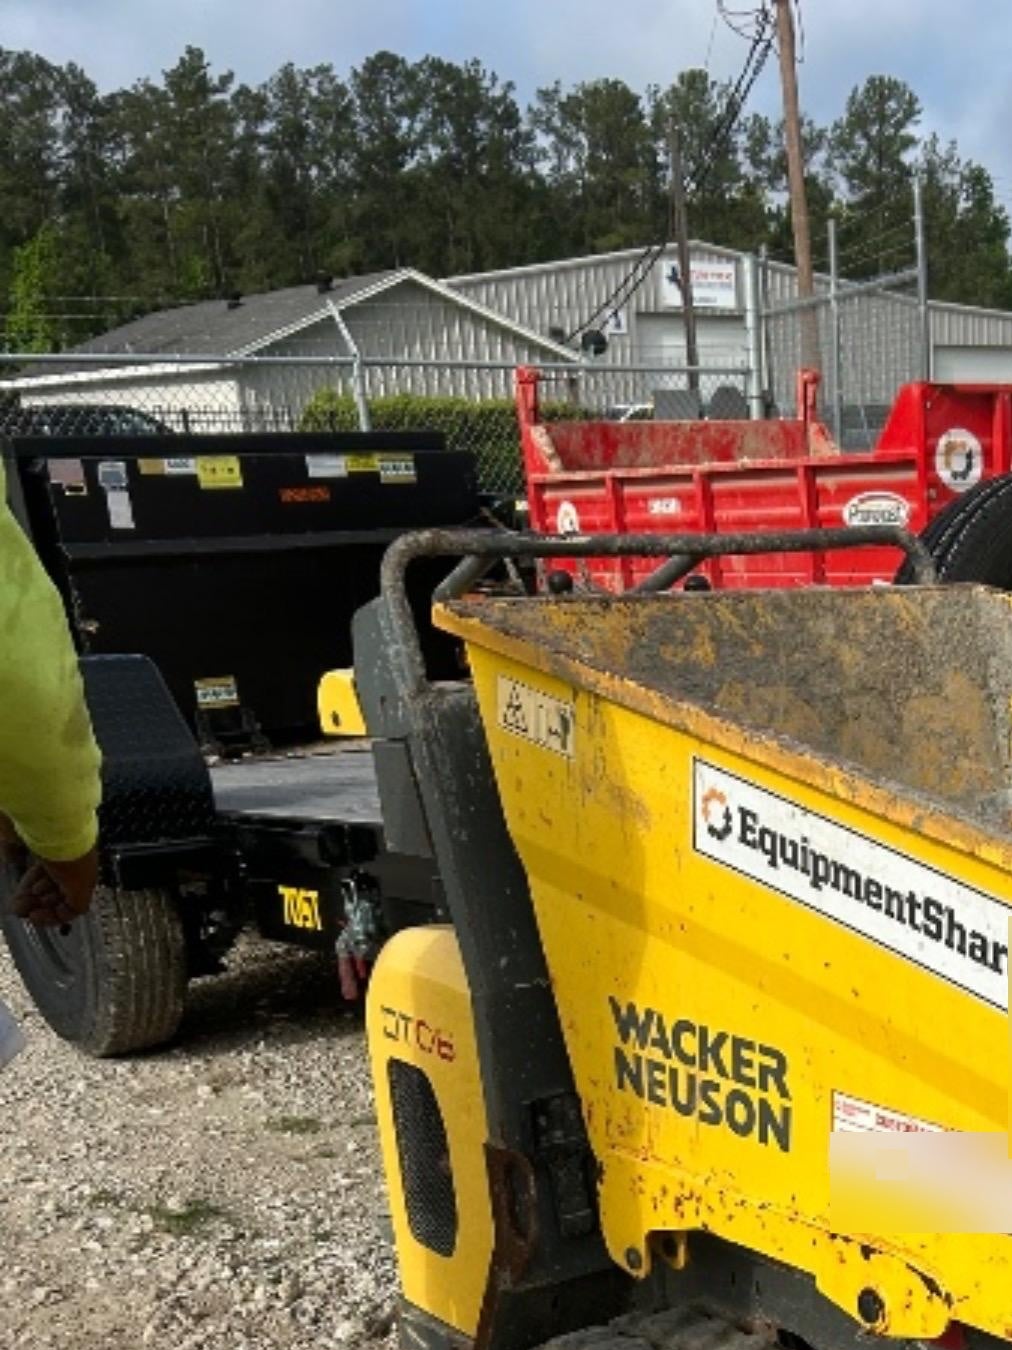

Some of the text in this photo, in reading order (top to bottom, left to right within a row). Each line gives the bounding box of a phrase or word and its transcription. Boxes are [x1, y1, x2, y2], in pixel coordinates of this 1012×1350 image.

[737, 806, 1009, 975] EquipmentShar
[608, 995, 792, 1101] WACKER
[614, 1046, 792, 1153] NEUSON
